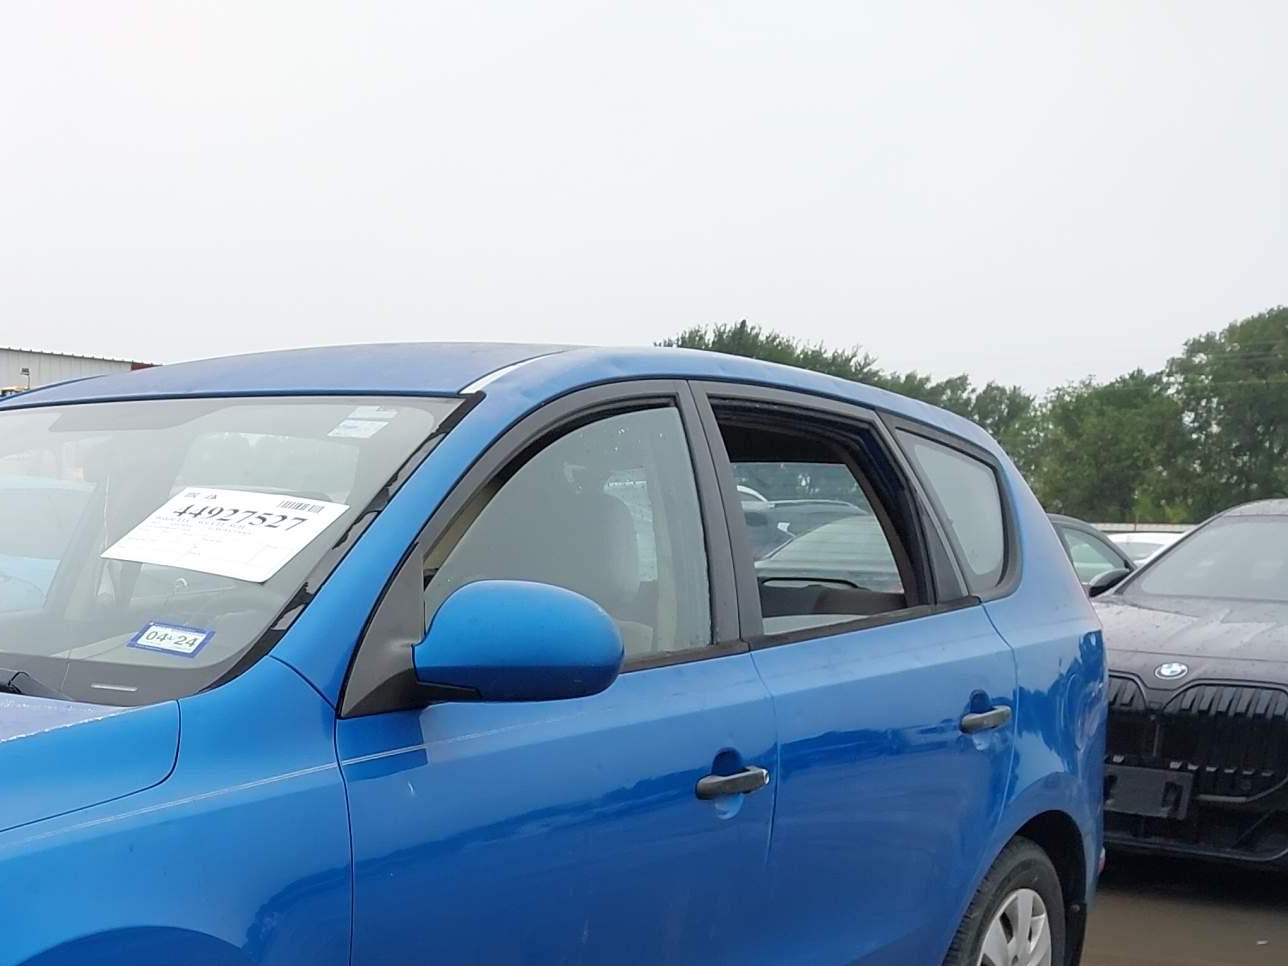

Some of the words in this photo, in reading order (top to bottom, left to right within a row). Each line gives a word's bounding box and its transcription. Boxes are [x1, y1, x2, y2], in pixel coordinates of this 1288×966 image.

[173, 504, 308, 531] 44927527
[145, 630, 169, 642] 04
[173, 635, 199, 648] 24
